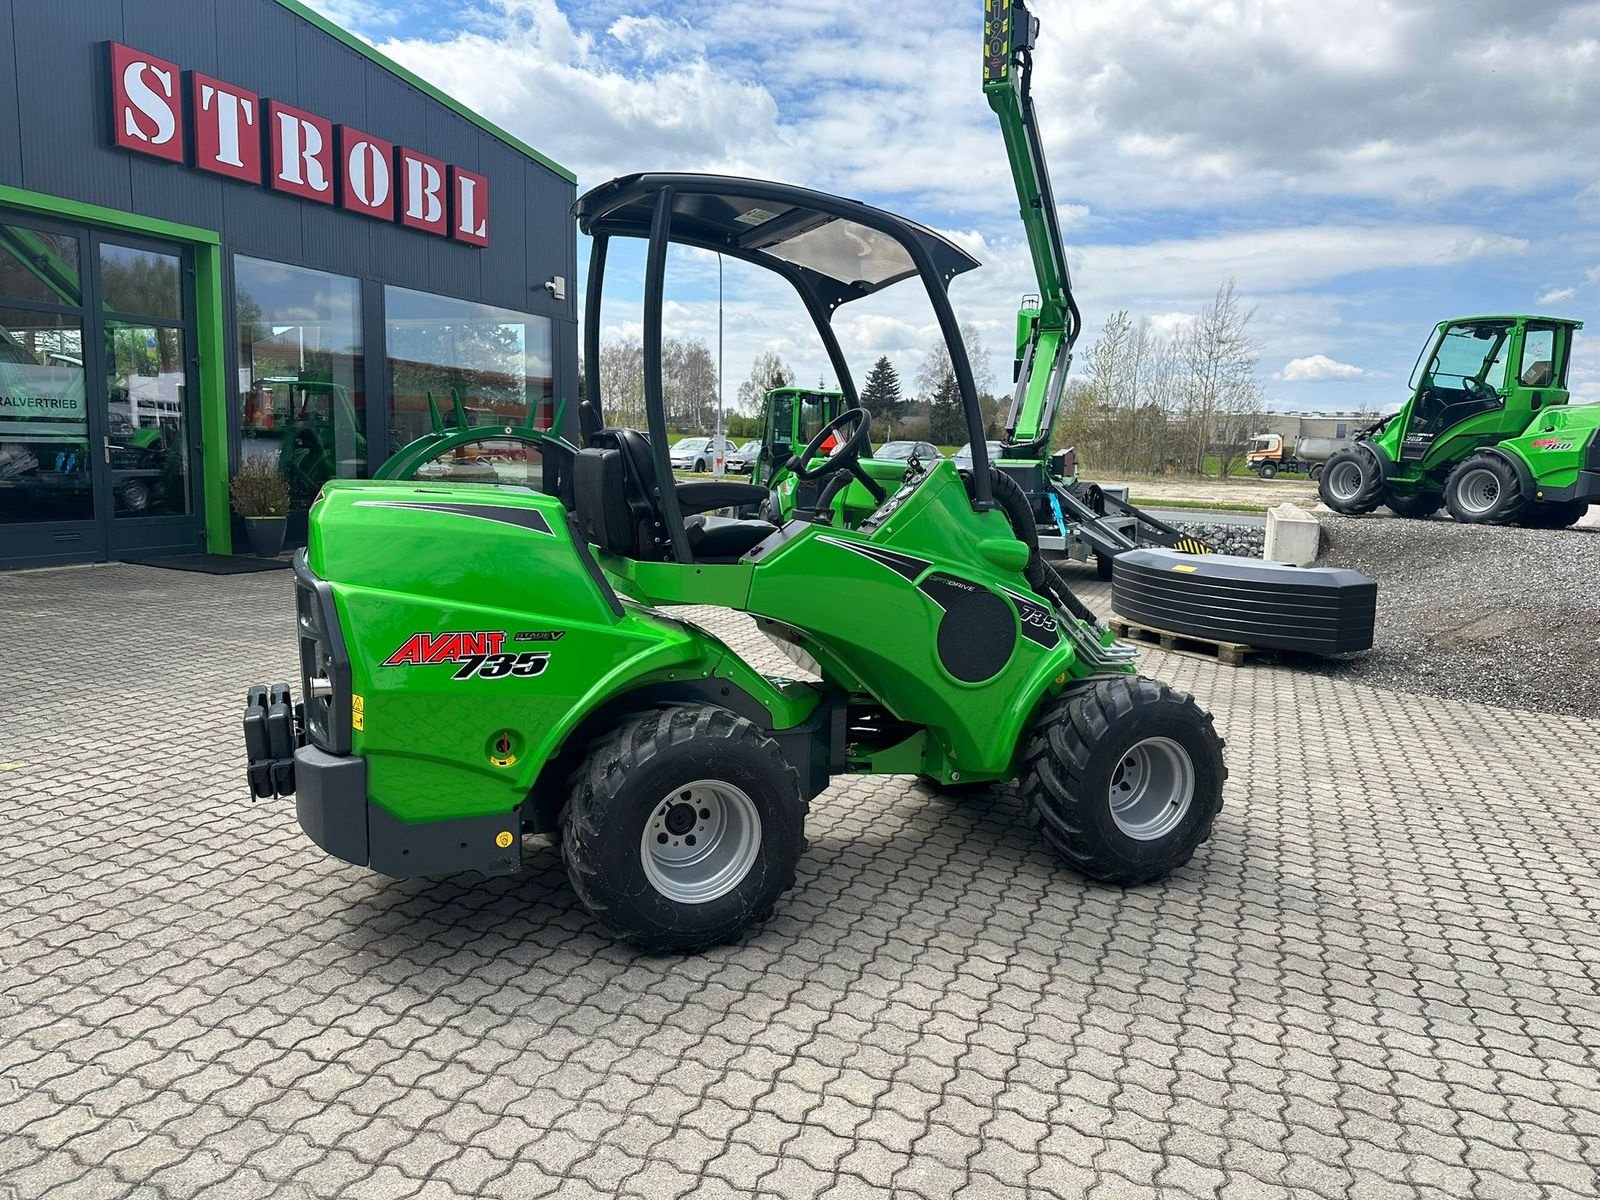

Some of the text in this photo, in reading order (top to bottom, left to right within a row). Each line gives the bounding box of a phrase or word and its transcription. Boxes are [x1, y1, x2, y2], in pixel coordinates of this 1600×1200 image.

[123, 61, 486, 238] STROBL
[1020, 605, 1057, 631] 735
[382, 632, 504, 666] AVANT
[451, 651, 551, 681] 735
